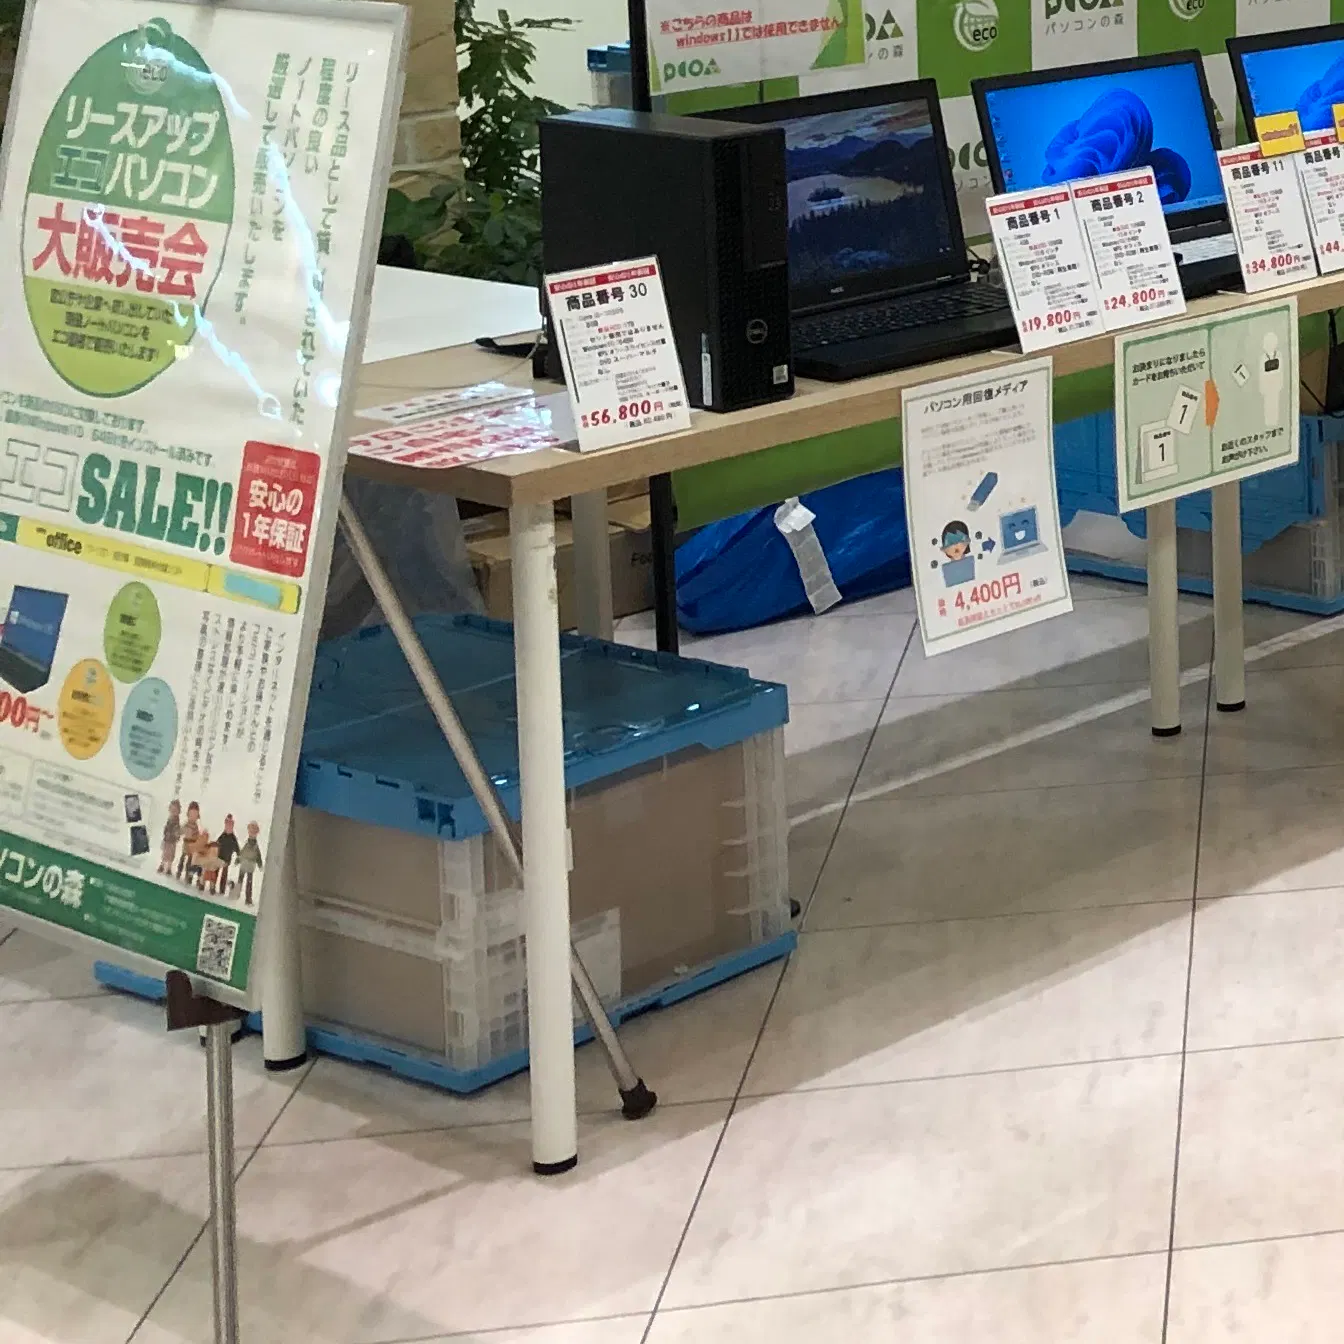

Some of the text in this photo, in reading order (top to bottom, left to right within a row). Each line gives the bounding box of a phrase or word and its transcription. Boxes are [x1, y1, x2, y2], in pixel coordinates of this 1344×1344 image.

[972, 25, 998, 41] eco
[1045, 13, 1124, 35] パソコンの森
[66, 95, 220, 157] リースアップ
[269, 55, 313, 242] ノートパソンを
[1304, 146, 1341, 164] 商品番号
[51, 144, 219, 210] エコパソコン
[1231, 159, 1284, 180] 商品番号 11
[1090, 191, 1145, 212] 商品番号 2
[1006, 208, 1060, 231] 商品番号 1
[32, 201, 210, 301] 大販売会
[565, 282, 648, 312] 商品番号 30
[923, 379, 1029, 415] パソコン用回復メディア
[1158, 443, 1165, 462] 1
[249, 478, 304, 516] 安心の
[954, 572, 1021, 610] 4,400円
